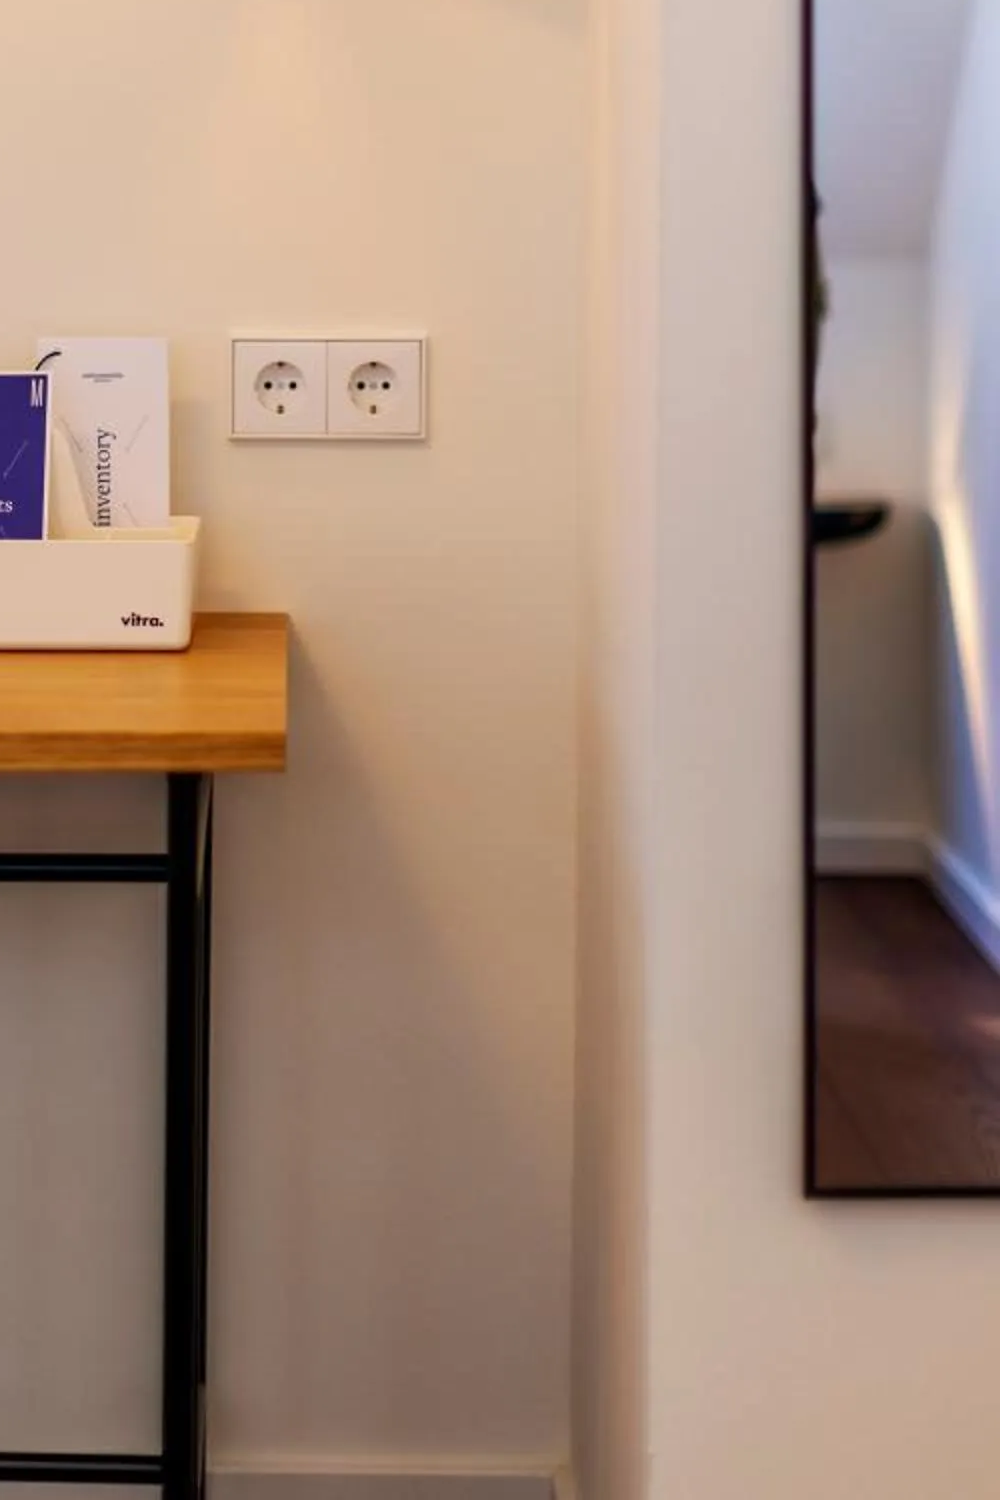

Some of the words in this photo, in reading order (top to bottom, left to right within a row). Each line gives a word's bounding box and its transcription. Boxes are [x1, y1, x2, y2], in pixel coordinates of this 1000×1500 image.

[30, 378, 44, 408] M
[93, 427, 117, 528] inventory
[120, 611, 165, 627] vitra.
